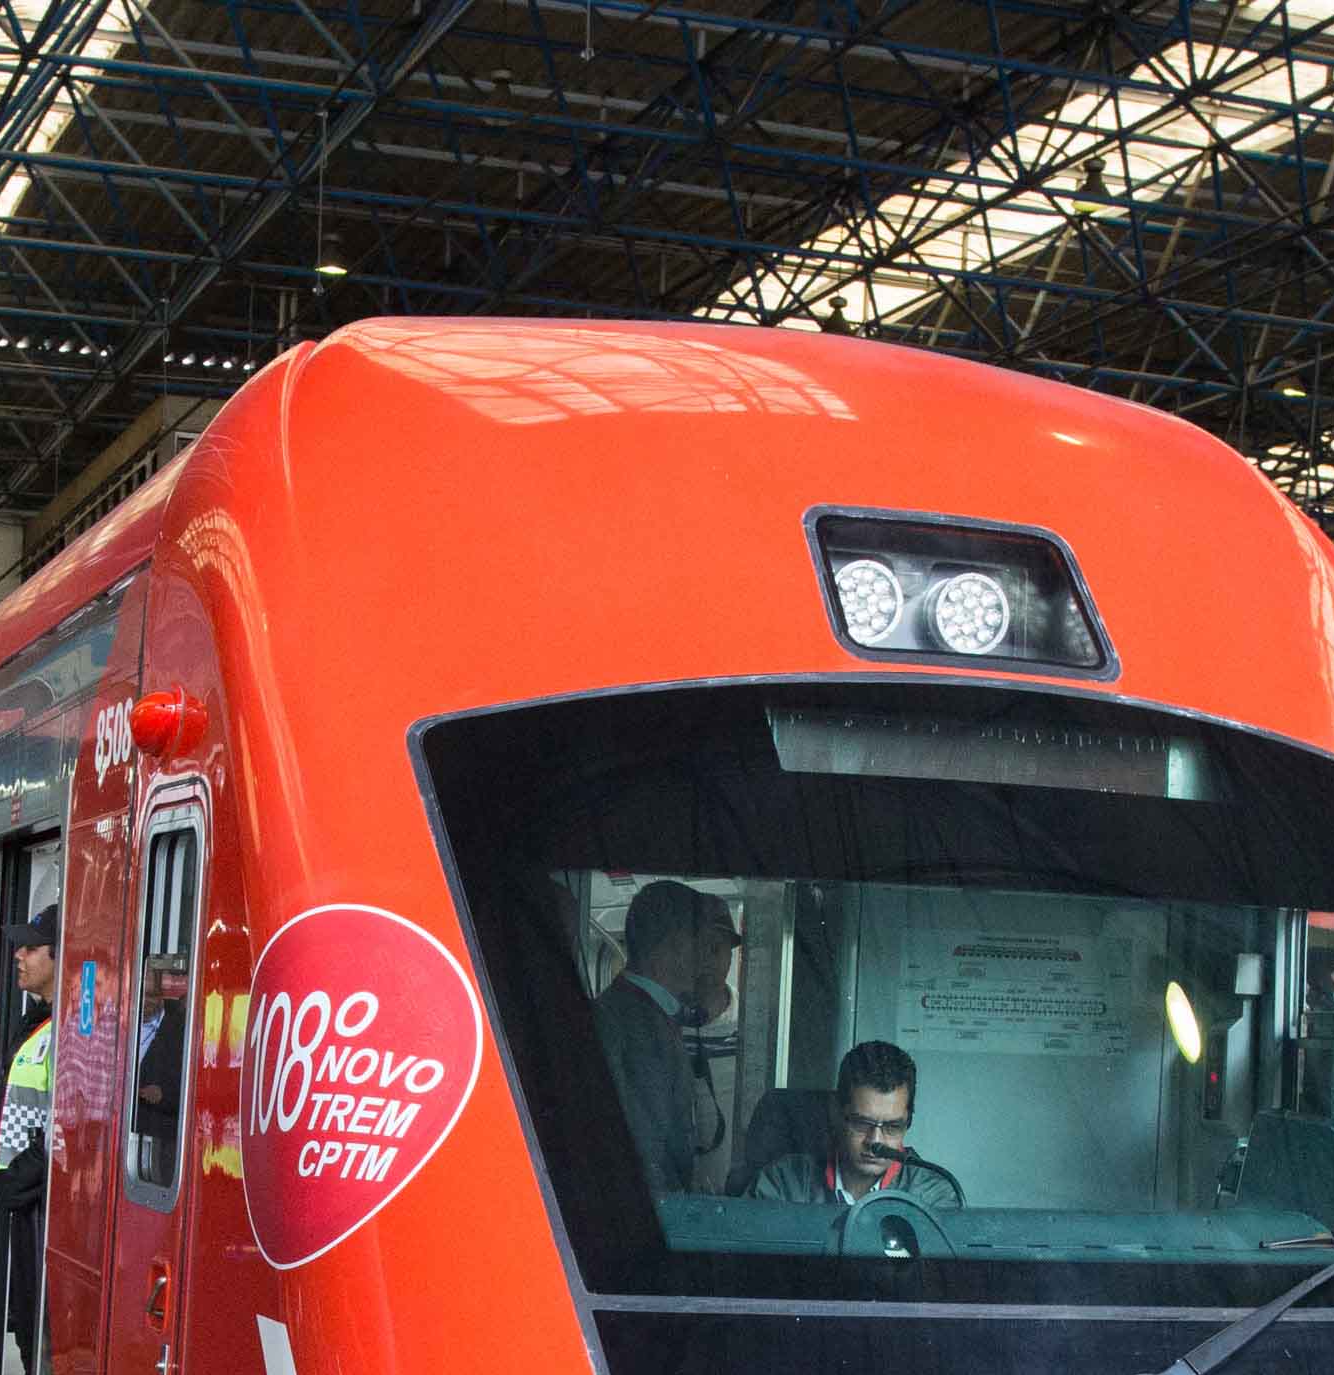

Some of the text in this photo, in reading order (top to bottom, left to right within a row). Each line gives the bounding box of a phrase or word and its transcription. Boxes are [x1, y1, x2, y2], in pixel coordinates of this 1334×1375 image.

[316, 1045, 444, 1094] NOVO
[307, 1093, 422, 1139] TREM
[298, 1140, 399, 1182] CPTM
